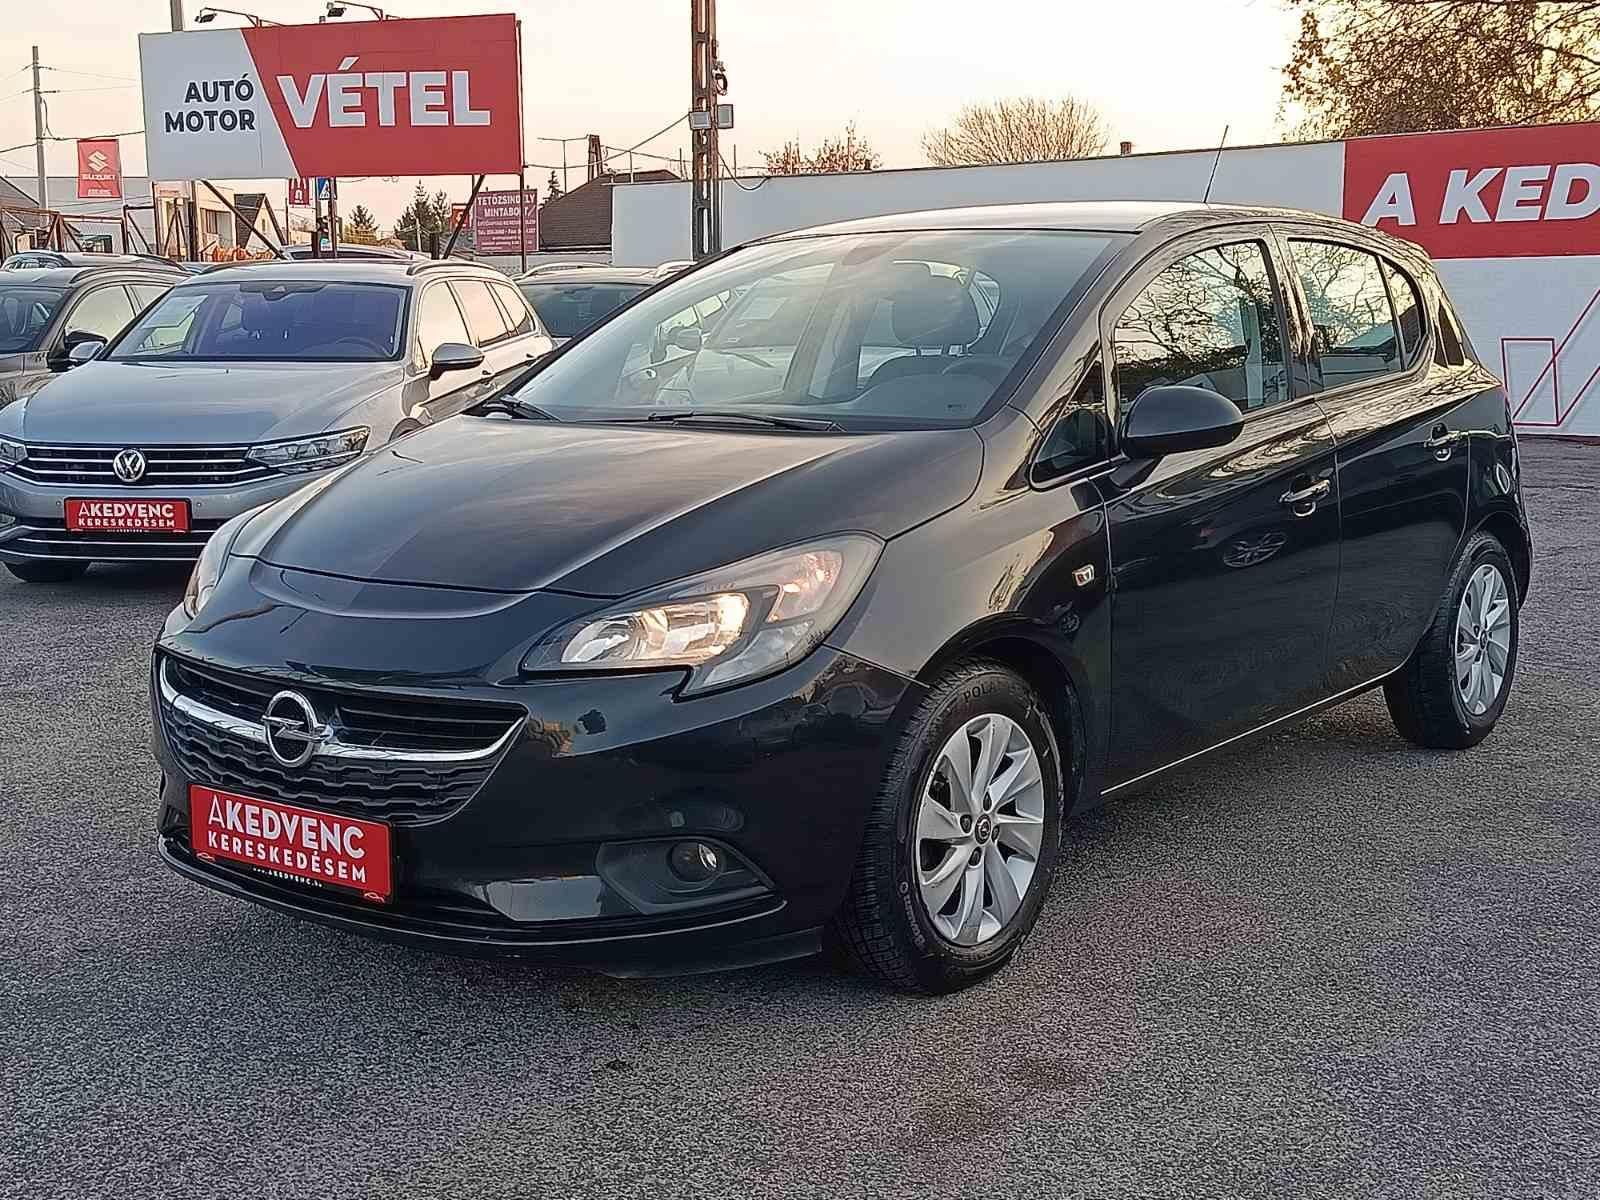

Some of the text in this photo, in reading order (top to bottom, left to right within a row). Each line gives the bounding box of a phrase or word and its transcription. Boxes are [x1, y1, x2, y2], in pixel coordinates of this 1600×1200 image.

[184, 73, 254, 103] AUTÓ
[276, 56, 491, 129] VÉTEL
[164, 109, 256, 133] MOTOR
[1360, 162, 1600, 226] A KED
[78, 517, 175, 527] KERESKEDÉSEM
[208, 830, 367, 884] KERESKEDÉSEM
